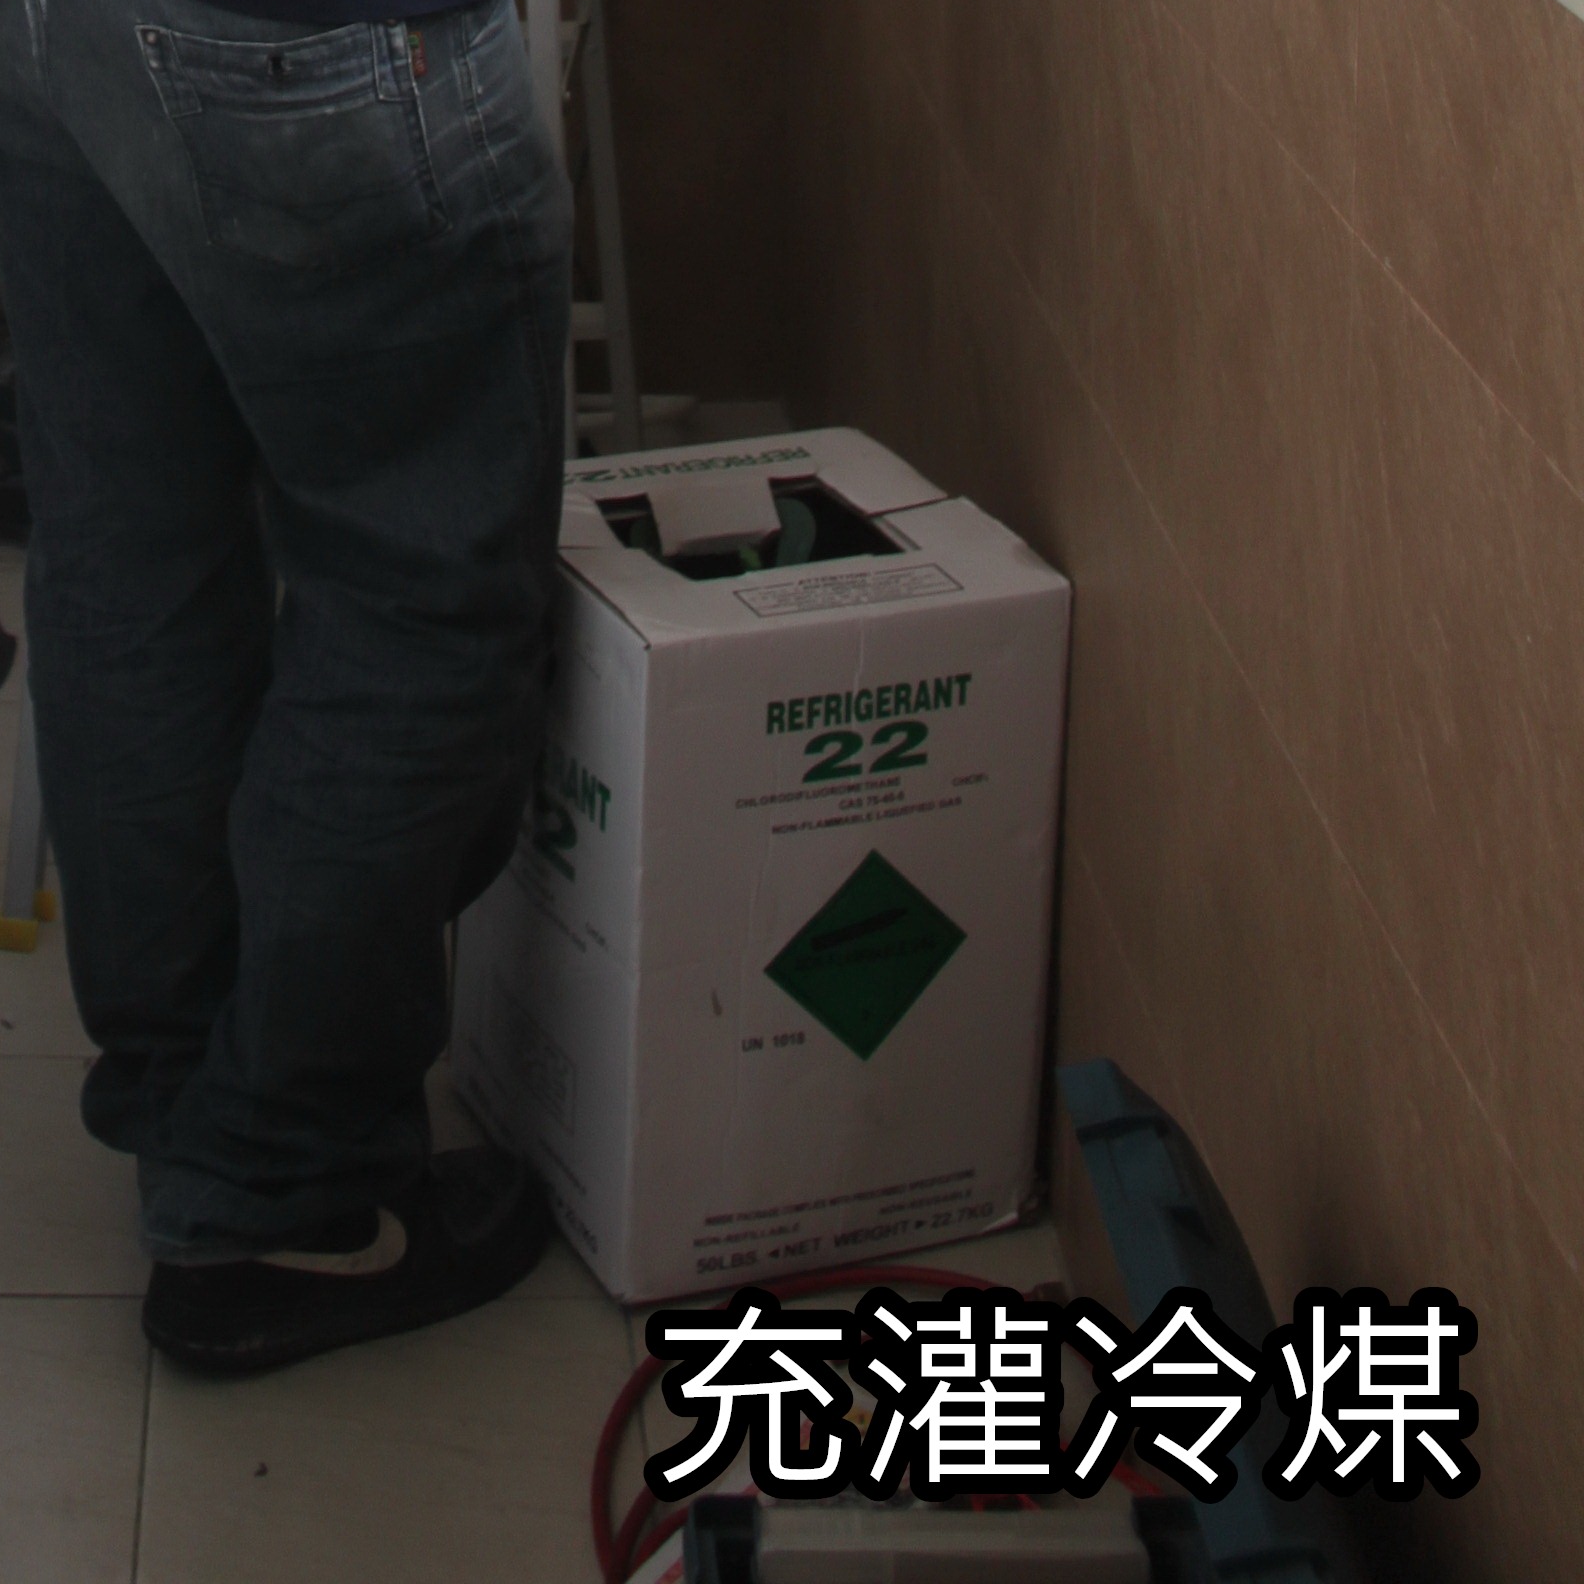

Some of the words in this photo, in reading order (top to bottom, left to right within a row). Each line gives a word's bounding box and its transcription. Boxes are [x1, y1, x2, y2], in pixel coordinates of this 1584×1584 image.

[766, 672, 973, 735] REFRIGERANT
[802, 720, 929, 784] 22
[742, 1036, 764, 1052] UN
[696, 1249, 758, 1275] 50LBS
[783, 1237, 821, 1259] NET
[833, 1218, 910, 1248] WEIGHT
